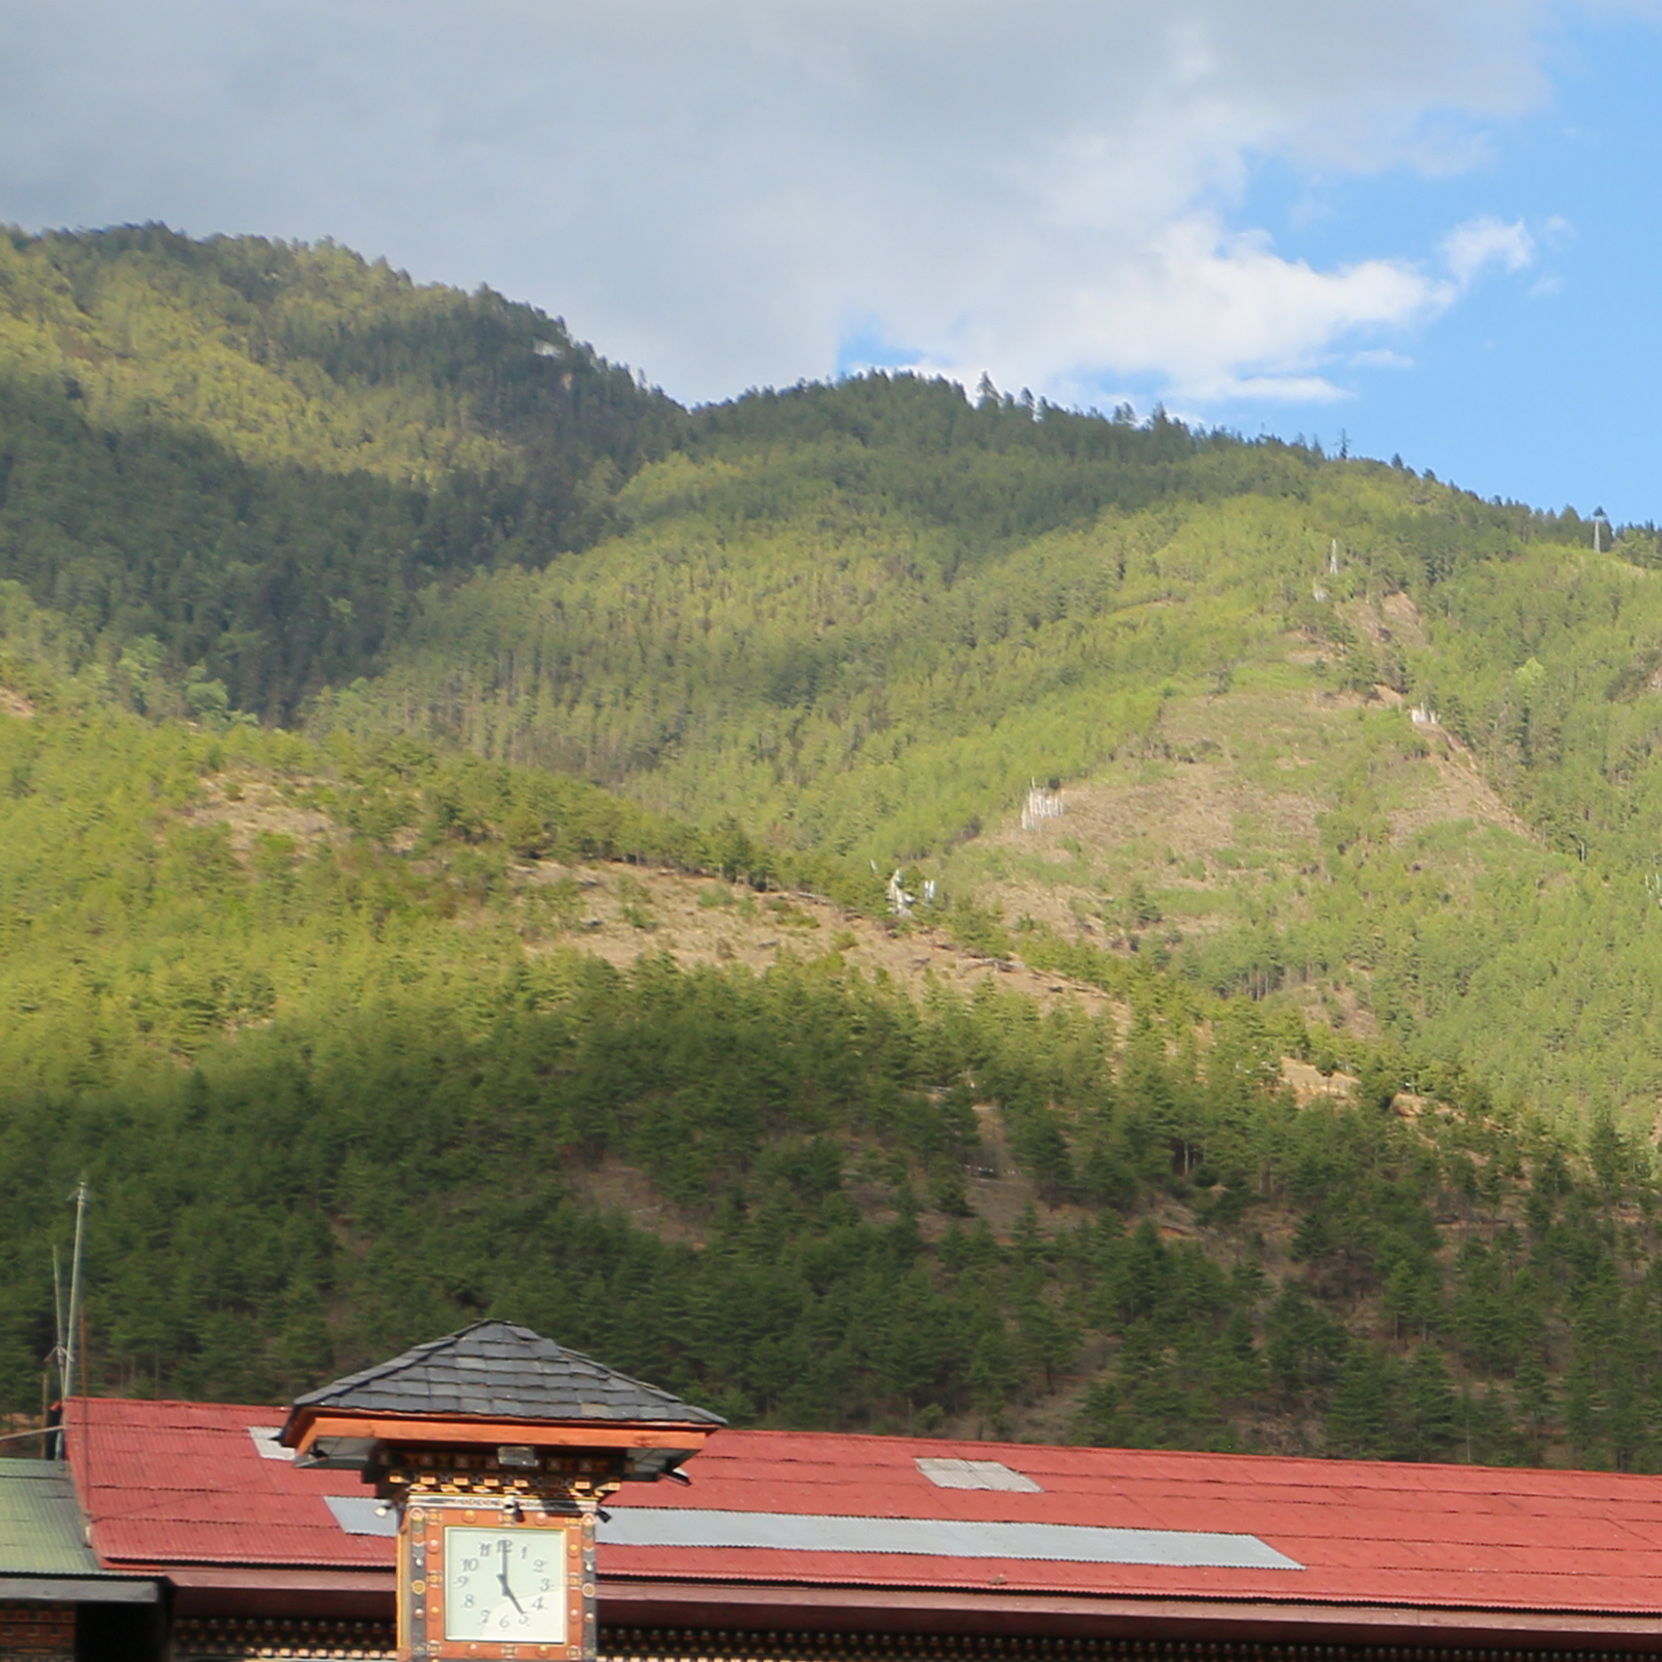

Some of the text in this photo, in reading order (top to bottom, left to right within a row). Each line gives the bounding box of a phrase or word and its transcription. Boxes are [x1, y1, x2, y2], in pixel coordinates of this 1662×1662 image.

[480, 1543, 491, 1557] 11
[521, 1546, 528, 1559] 1
[463, 1558, 479, 1572] 10
[533, 1559, 545, 1573] 2
[457, 1576, 468, 1588] 9
[540, 1578, 550, 1591] 3
[464, 1594, 475, 1608] 8
[531, 1597, 543, 1610] 4
[481, 1609, 490, 1623] 7
[499, 1615, 510, 1628] 6
